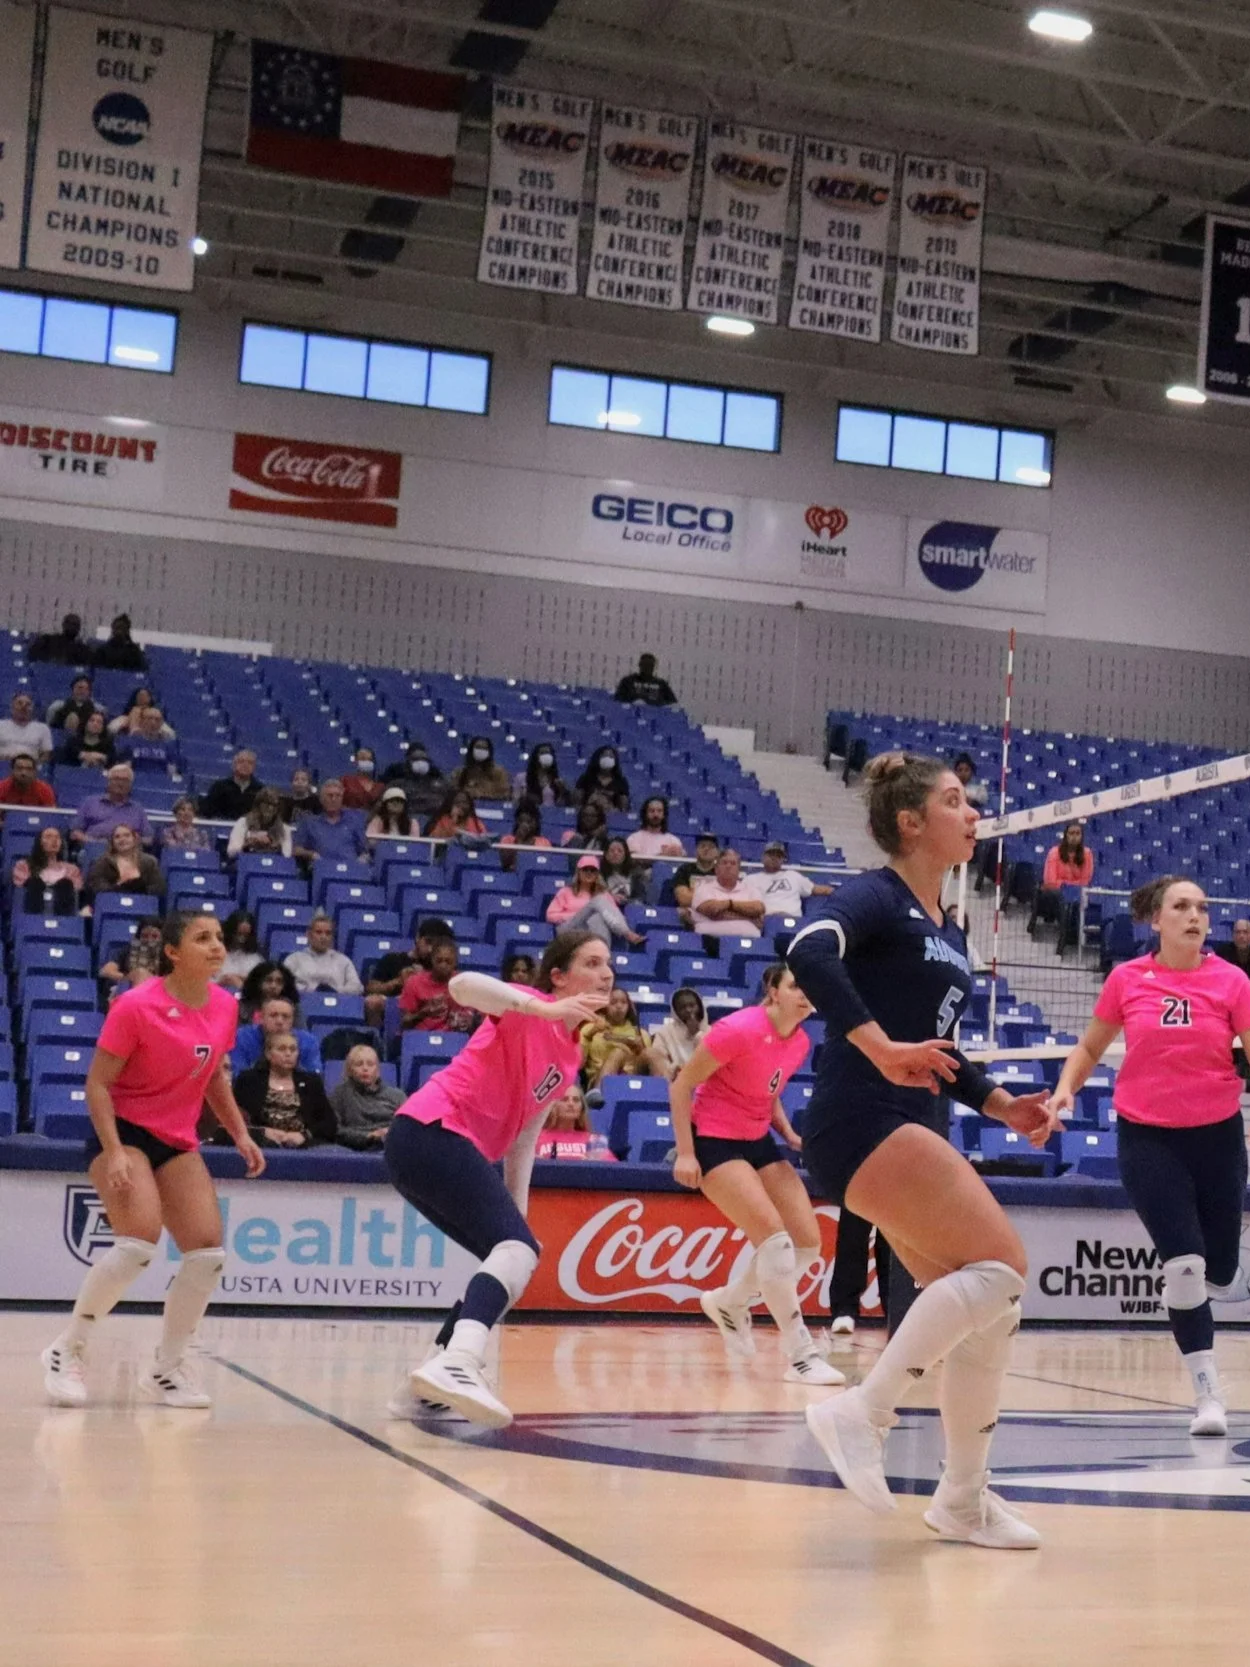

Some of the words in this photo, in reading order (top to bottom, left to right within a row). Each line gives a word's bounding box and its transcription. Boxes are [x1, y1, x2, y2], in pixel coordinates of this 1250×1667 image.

[96, 28, 164, 55] MEN'S
[96, 58, 157, 83] GOLF
[99, 117, 150, 135] NCAA
[504, 122, 585, 153] MEAC
[57, 149, 156, 182] DIVISION
[611, 142, 690, 173] MEAC
[716, 153, 788, 188] MEAC
[519, 168, 554, 189] 2015
[816, 177, 890, 205] MEAC
[58, 183, 171, 217] NATIONAL
[492, 188, 579, 216] MID-EASTERN
[626, 187, 660, 209] 2016
[728, 199, 760, 222] 2017
[914, 192, 980, 220] MEAC
[47, 211, 179, 248] CHAMPIONS
[500, 213, 566, 239] ATHLETIC
[600, 207, 683, 235] MID-EASTERN
[703, 219, 782, 249] MID-EASTERN
[827, 220, 861, 241] 2018
[63, 243, 159, 275] 2009-10
[608, 232, 672, 258] ATHLETIC
[709, 243, 770, 271] ATHLETIC
[803, 239, 883, 267] MID-EASTERN
[488, 261, 568, 289] CHAMPIONS
[810, 265, 873, 289] ATHLETIC
[901, 256, 976, 282] MID-EASTERN
[597, 279, 673, 306] CHAMPIONS
[698, 290, 771, 318] CHAMPIONS
[906, 281, 966, 304] ATHLETIC
[800, 308, 872, 336] CHAMPIONS
[898, 326, 969, 350] CHAMPIONS
[0, 422, 157, 463] DISCOUNT
[38, 454, 109, 477] TIRE
[261, 446, 367, 490] Coca-Cola
[591, 493, 734, 536] GEICO
[622, 525, 672, 546] Local
[676, 531, 731, 553] Office
[802, 540, 847, 557] iHeart
[936, 985, 965, 1038] 5
[1160, 996, 1192, 1027] 21
[193, 1045, 212, 1079] 7
[532, 1064, 563, 1104] 18
[1076, 1241, 1164, 1270] New
[294, 1277, 442, 1297] UNIVERSITY
